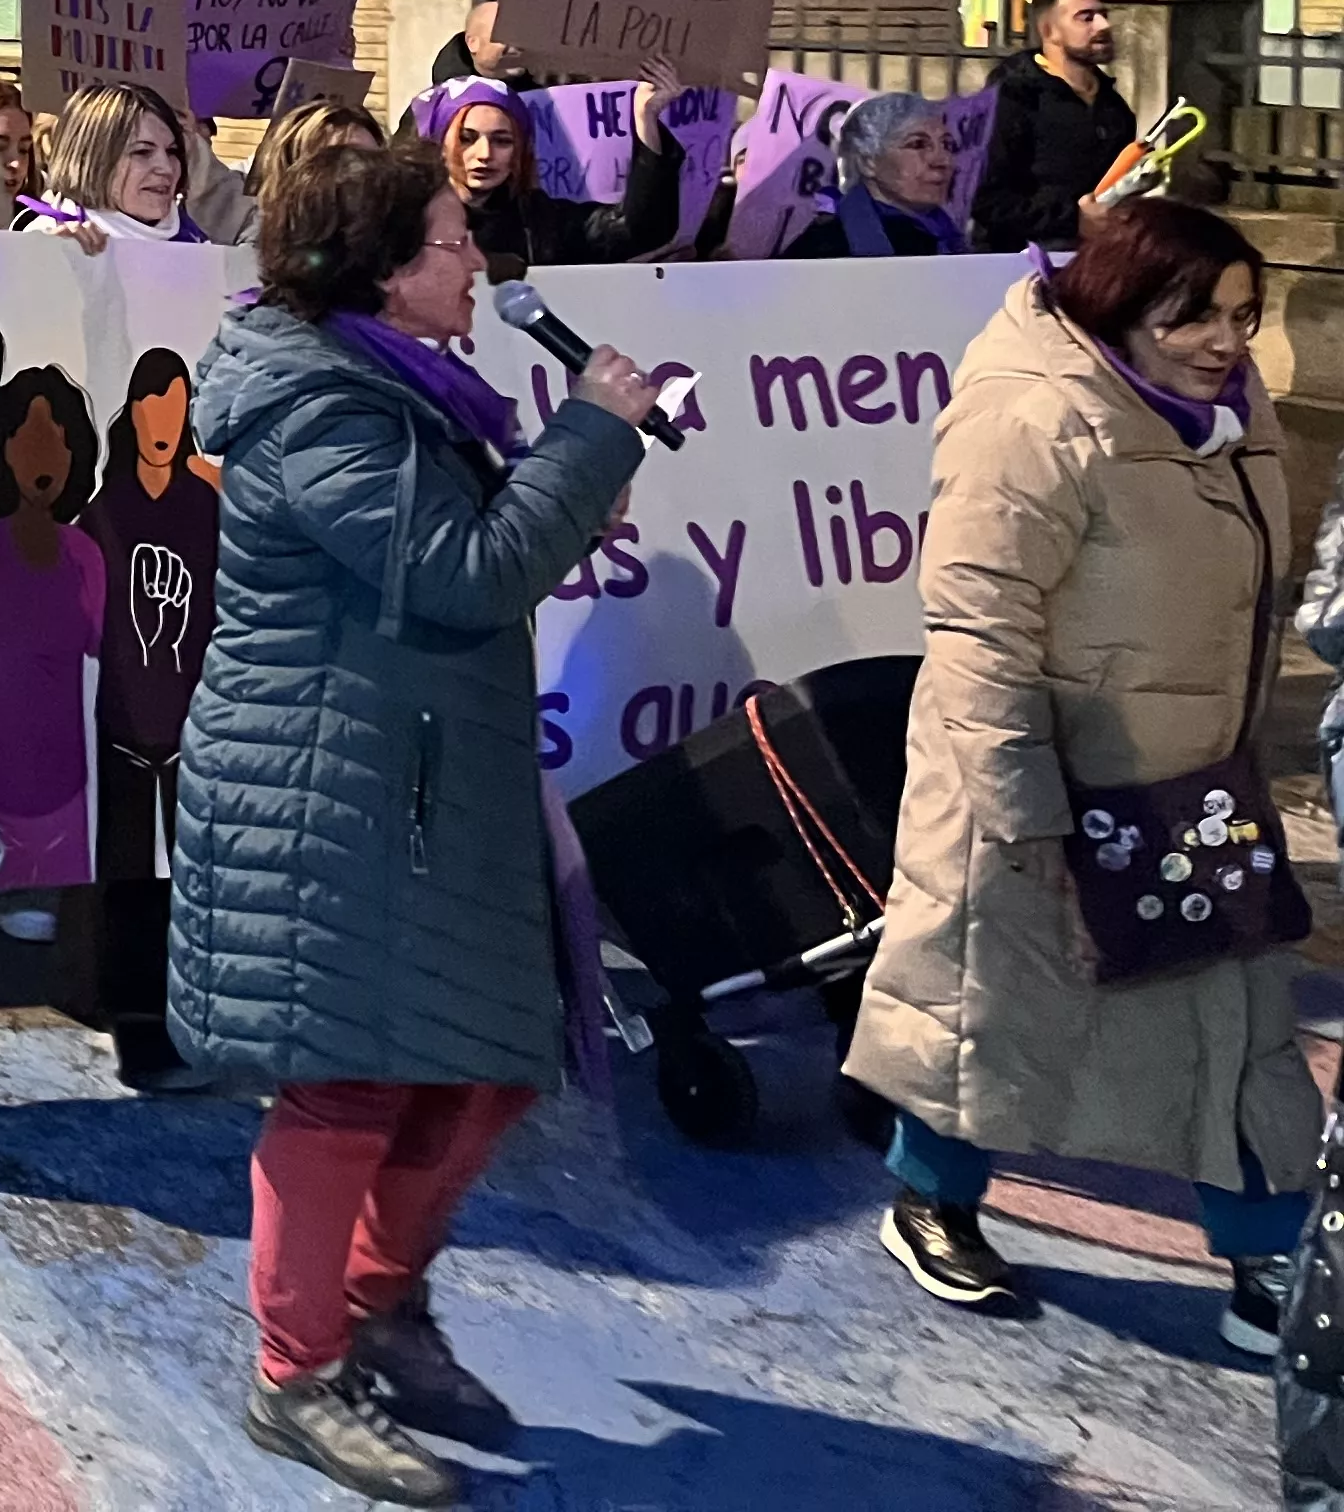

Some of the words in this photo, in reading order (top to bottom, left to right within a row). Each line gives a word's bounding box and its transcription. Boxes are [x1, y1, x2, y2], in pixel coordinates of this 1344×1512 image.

[188, 22, 232, 53] POR
[241, 24, 267, 49] LA
[617, 5, 692, 56] POLI
[686, 518, 746, 628] y
[793, 479, 930, 588] lib
